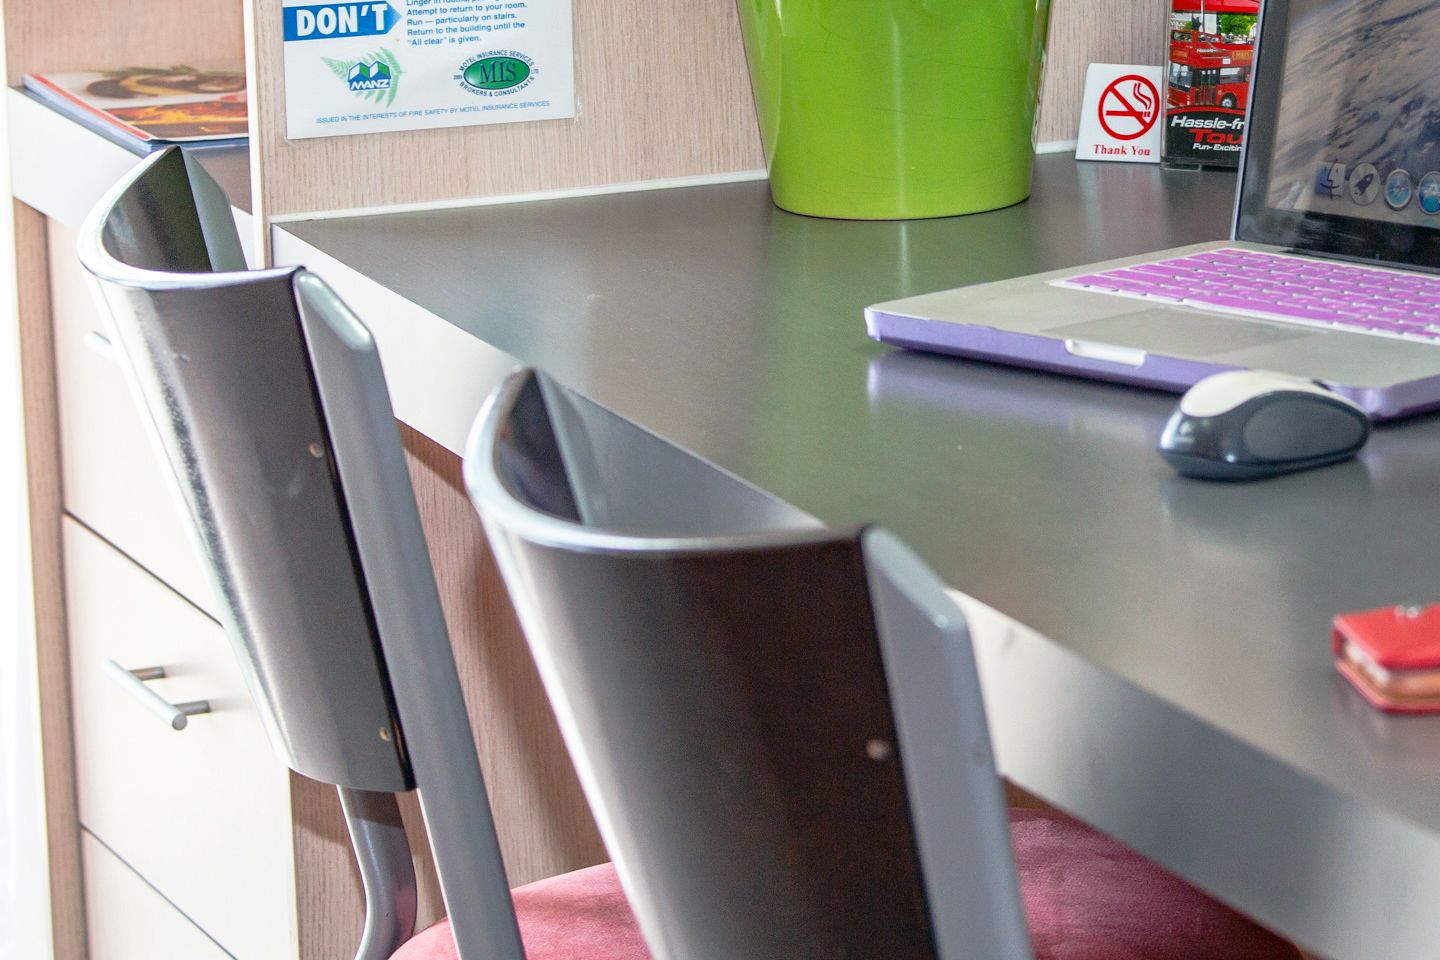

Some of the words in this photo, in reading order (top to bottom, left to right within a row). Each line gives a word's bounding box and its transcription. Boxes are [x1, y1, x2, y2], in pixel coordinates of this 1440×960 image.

[407, 8, 437, 16] Attempt
[296, 3, 388, 37] DON'T
[436, 15, 480, 25] particularly
[460, 24, 491, 32] building
[479, 61, 516, 84] MIS
[351, 79, 389, 90] MANZ
[1171, 116, 1245, 129] Hassle-fr
[1094, 144, 1127, 155] Thank
[1131, 146, 1151, 156] You
